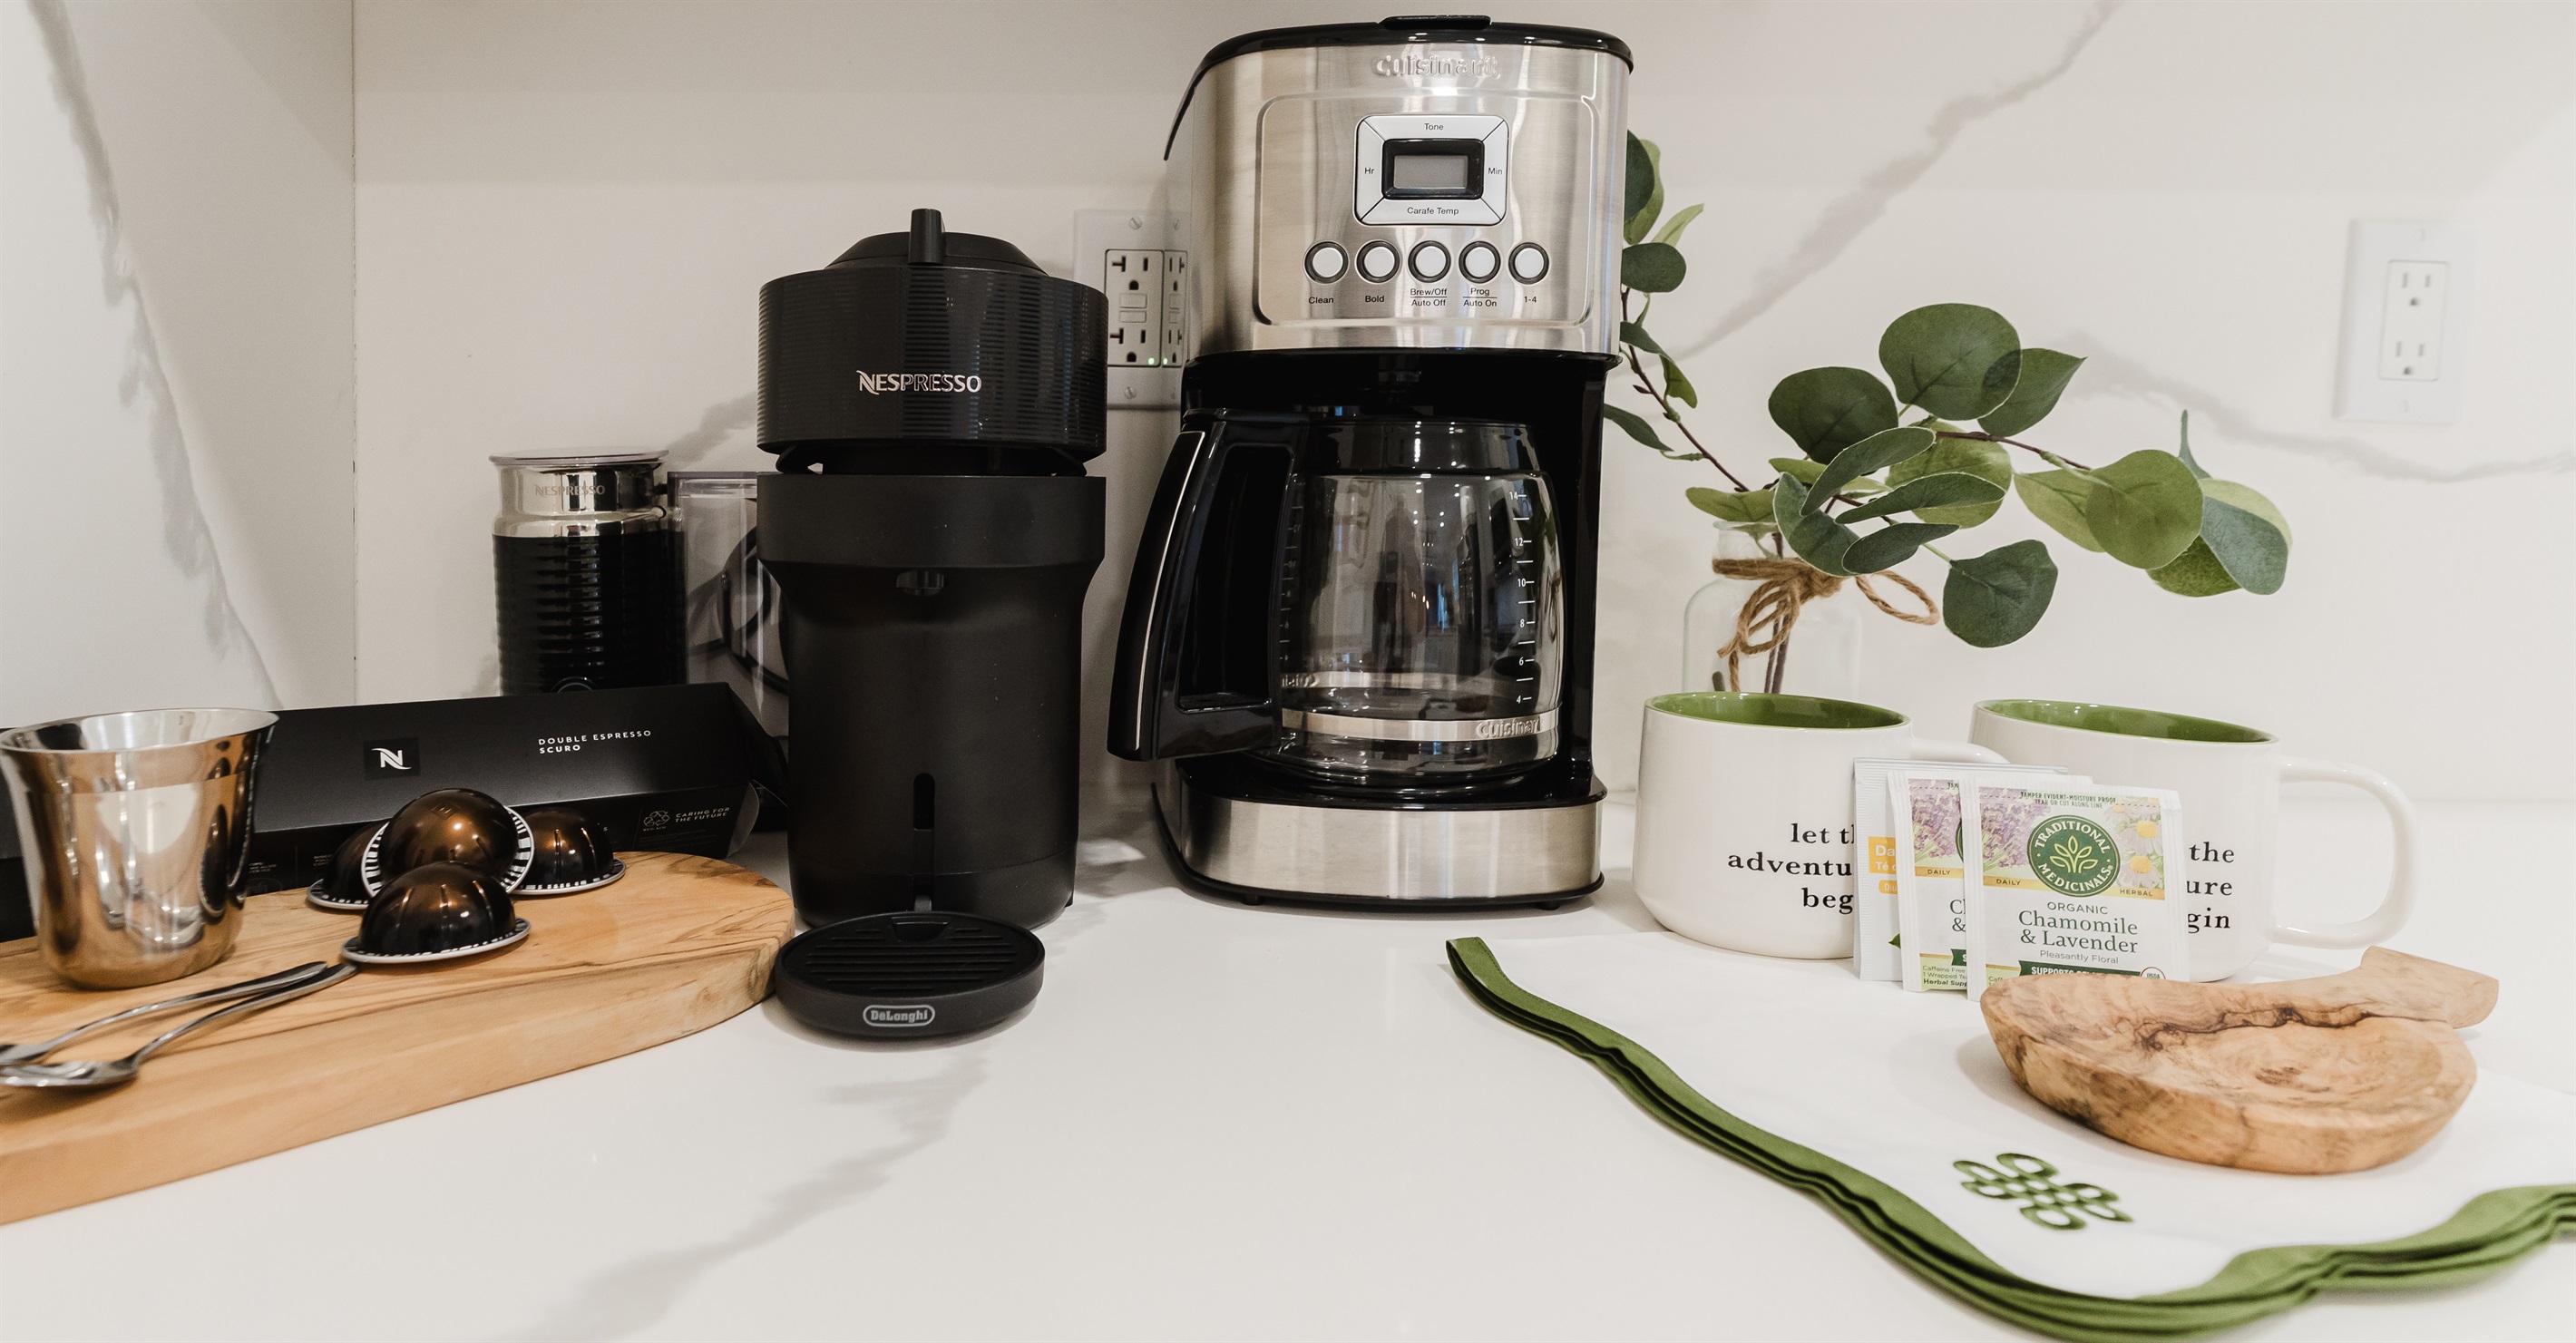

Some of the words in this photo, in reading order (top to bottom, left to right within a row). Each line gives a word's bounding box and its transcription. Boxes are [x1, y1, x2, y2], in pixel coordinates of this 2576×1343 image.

[1488, 167, 1503, 175] Min
[1407, 207, 1435, 215] Carafe
[1437, 207, 1459, 216] Temp
[1410, 287, 1448, 296] Brew/Off
[1470, 287, 1490, 297] Prog
[1308, 296, 1334, 305] Clean
[1364, 295, 1385, 303] Bold
[1463, 299, 1483, 307] Auto
[1485, 299, 1498, 307] On
[1524, 296, 1537, 304] 1-4
[855, 370, 982, 395] NESPRESSO
[535, 484, 606, 497] NESPRESSO
[1509, 491, 1518, 500] 14
[1514, 537, 1524, 547] 12
[1517, 578, 1527, 588] 10
[1519, 618, 1525, 628] 8
[1518, 657, 1524, 666] 6
[1516, 695, 1521, 704] 4
[538, 735, 588, 745] DOUBLE
[592, 730, 651, 741] ESPRESSO
[539, 744, 581, 754] SCURO
[2020, 792, 2042, 800] TAMPER
[2098, 796, 2116, 804] PROOF
[676, 810, 710, 818] CARING
[694, 813, 727, 821] FUTURE
[1791, 822, 1830, 844] let
[2034, 820, 2111, 854] TRADITIONAL
[1875, 845, 1895, 856] Da
[2189, 841, 2235, 863] the
[1728, 852, 1852, 876] adventu
[1995, 878, 2021, 887] DAILY
[2119, 889, 2153, 897] HERBAL
[2186, 881, 2233, 896] ure
[1800, 887, 1854, 915] beg
[2046, 901, 2108, 915] ORGANIC
[2018, 910, 2138, 936] Chamomile
[2187, 907, 2230, 934] gin
[2020, 929, 2037, 945] &
[2042, 929, 2139, 954] Lavender
[2040, 949, 2090, 963] Pleasantly
[2092, 954, 2119, 964] Floral
[1922, 965, 1950, 973] Caffeine
[1927, 972, 1957, 980] Wrapped
[1923, 978, 1949, 986] Herbal
